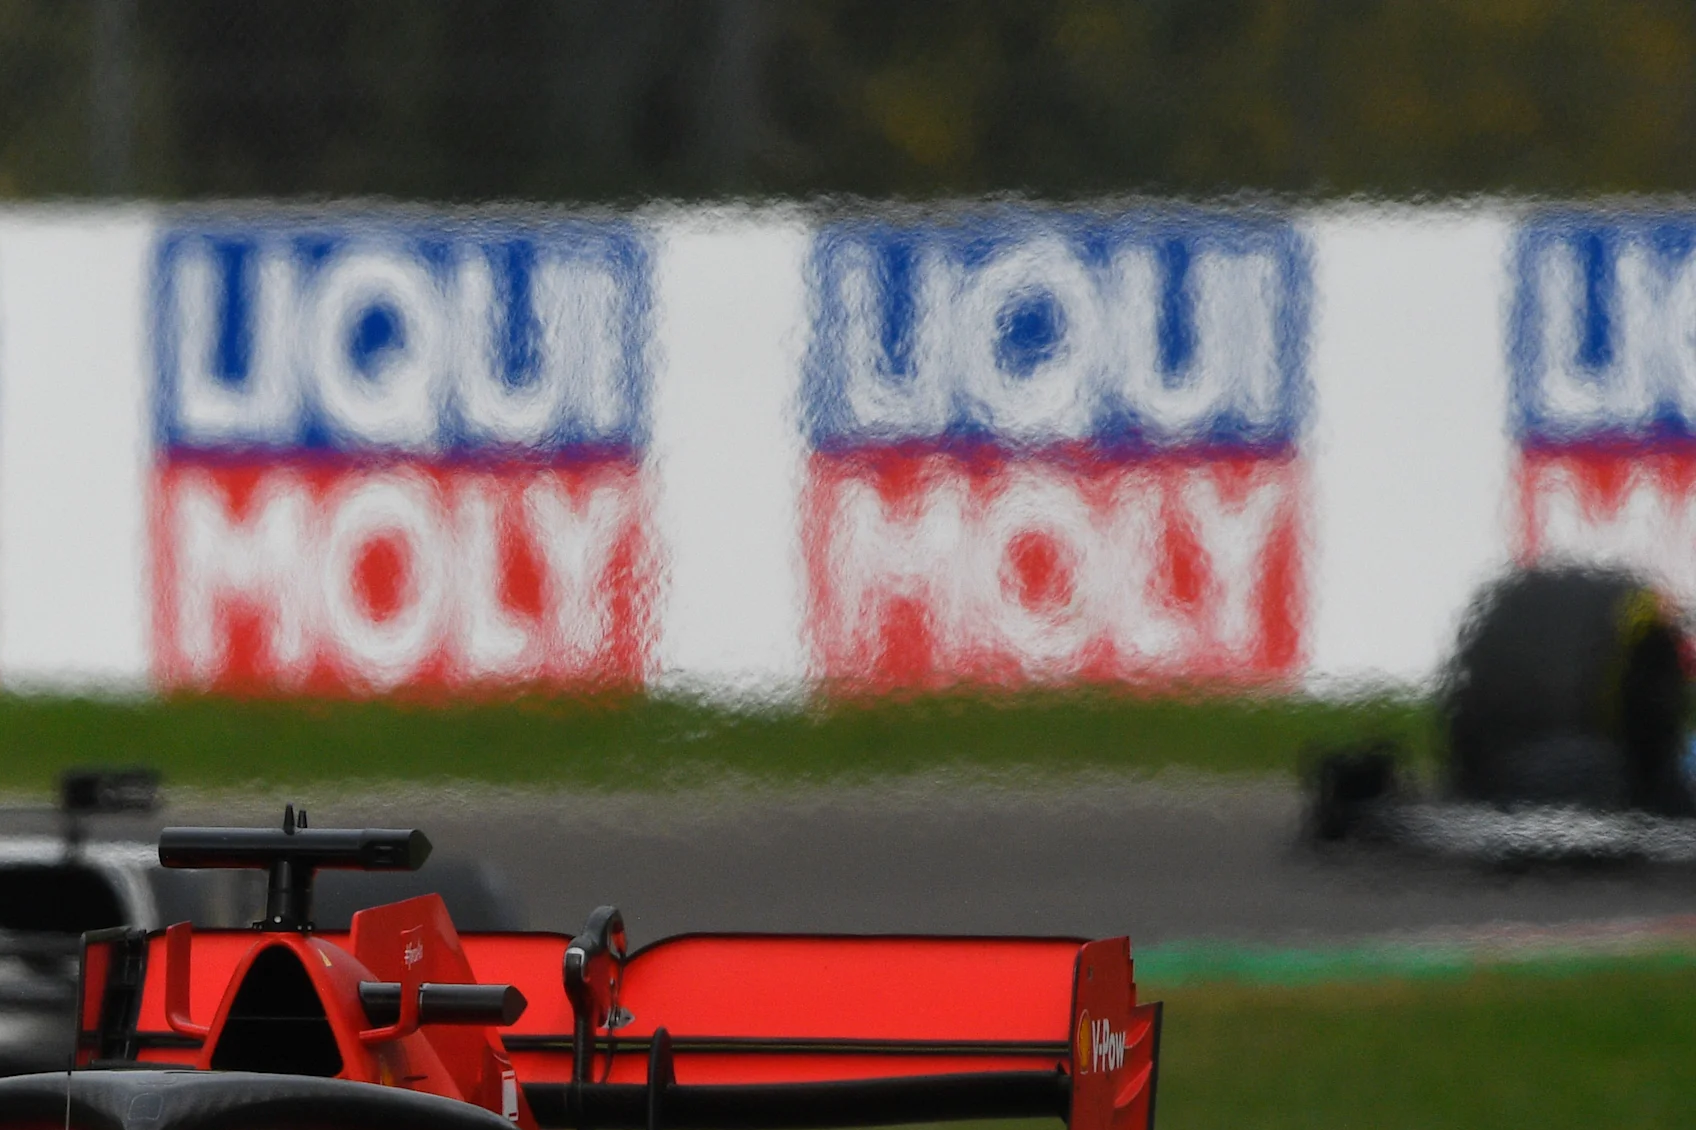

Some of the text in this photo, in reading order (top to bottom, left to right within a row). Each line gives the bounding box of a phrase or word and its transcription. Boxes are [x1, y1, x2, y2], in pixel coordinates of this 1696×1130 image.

[174, 245, 626, 446] LIQUI
[839, 236, 1284, 430] LIQUI
[172, 463, 636, 686] MOLY
[834, 463, 1289, 668] MOLY
